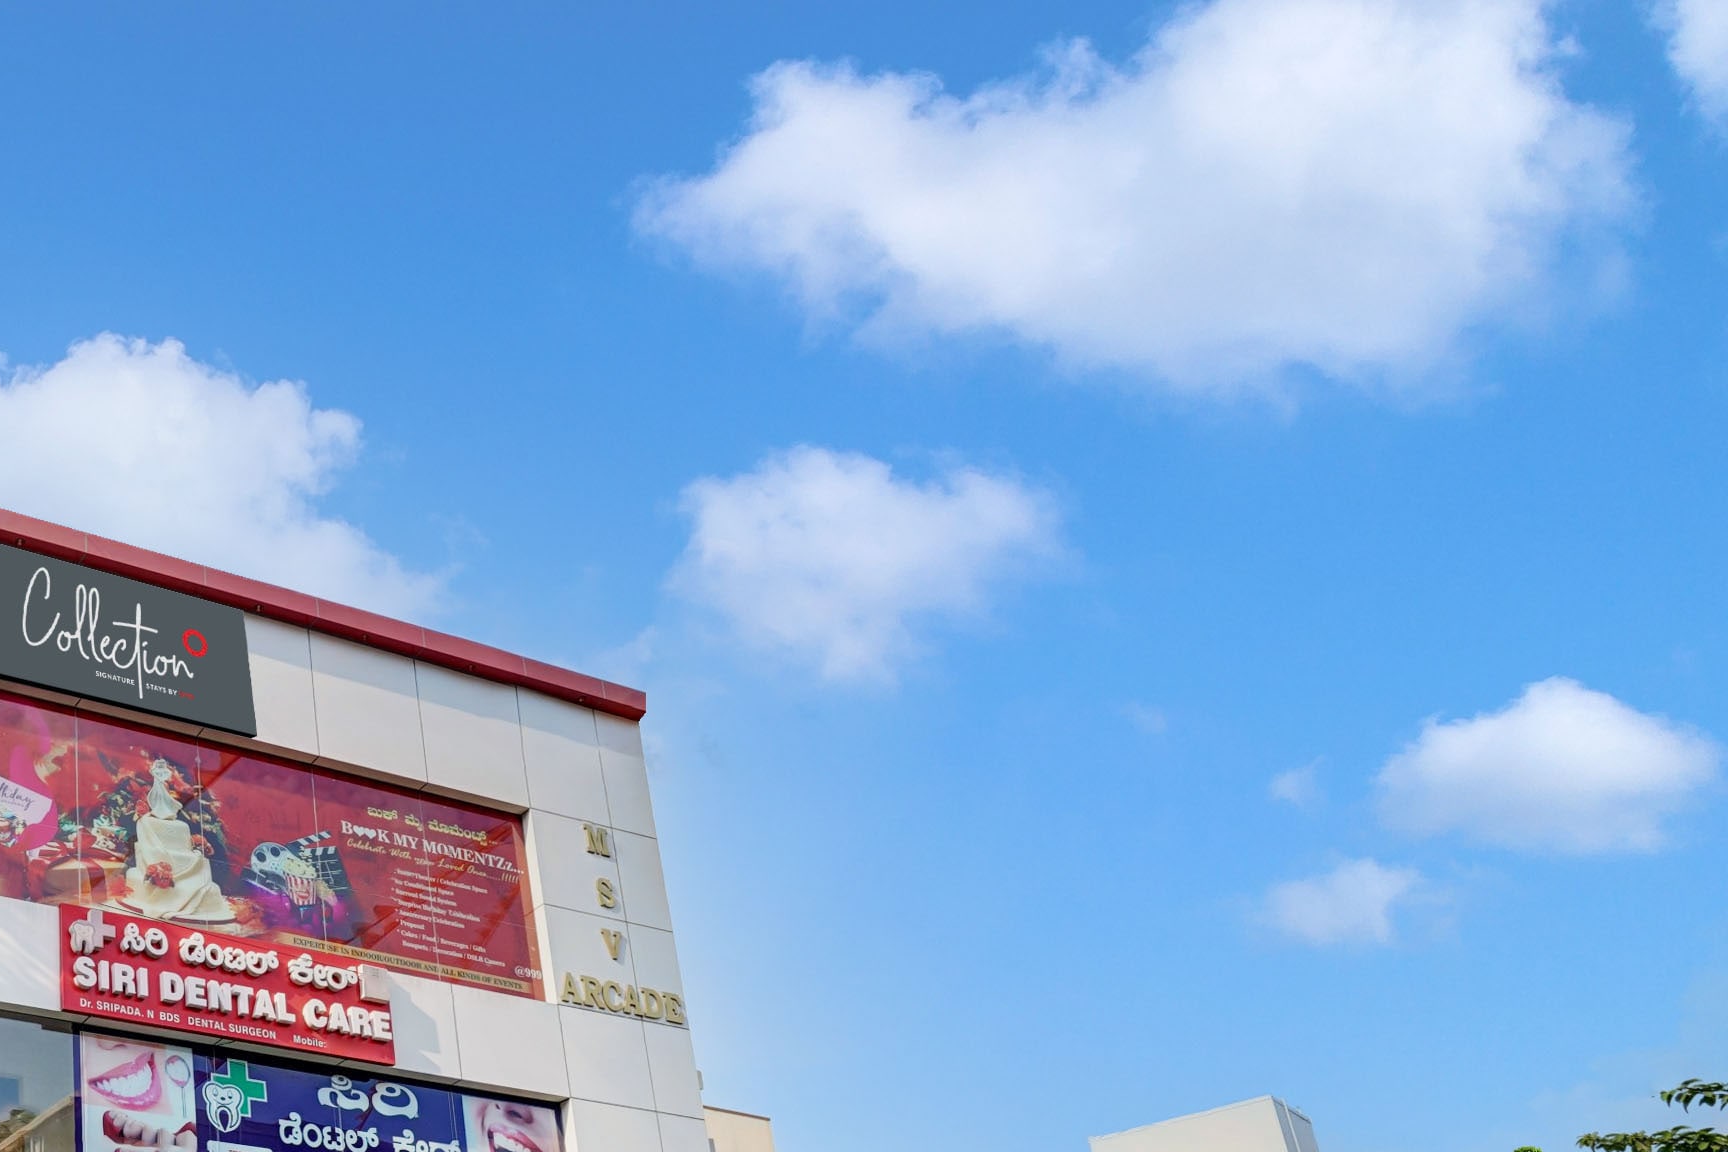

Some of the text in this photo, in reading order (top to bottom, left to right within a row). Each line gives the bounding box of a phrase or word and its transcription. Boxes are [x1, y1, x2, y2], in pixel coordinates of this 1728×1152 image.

[22, 566, 195, 700] Collection
[95, 670, 136, 686] SIGNATURE
[145, 683, 167, 694] STAYS
[167, 688, 178, 696] BY
[346, 837, 386, 855] Celebrate
[437, 858, 465, 872] Loved
[392, 832, 419, 849] MY
[120, 922, 359, 992] ಸಿರಿ ಡೆಂಟಲ್ ಕೇರ್
[340, 946, 350, 954] IN
[441, 968, 456, 978] ALL
[456, 971, 482, 983] KINDS
[482, 975, 493, 984] OF
[493, 978, 523, 990] EVENTS
[73, 955, 394, 1042] SIRI DENTAL CARE
[561, 971, 685, 1025] ARCADE
[79, 997, 327, 1048] Dr. SRIPADA. N BDS DENTAL SURGEON Mobile:
[317, 1074, 419, 1119] ಸಿರಿ
